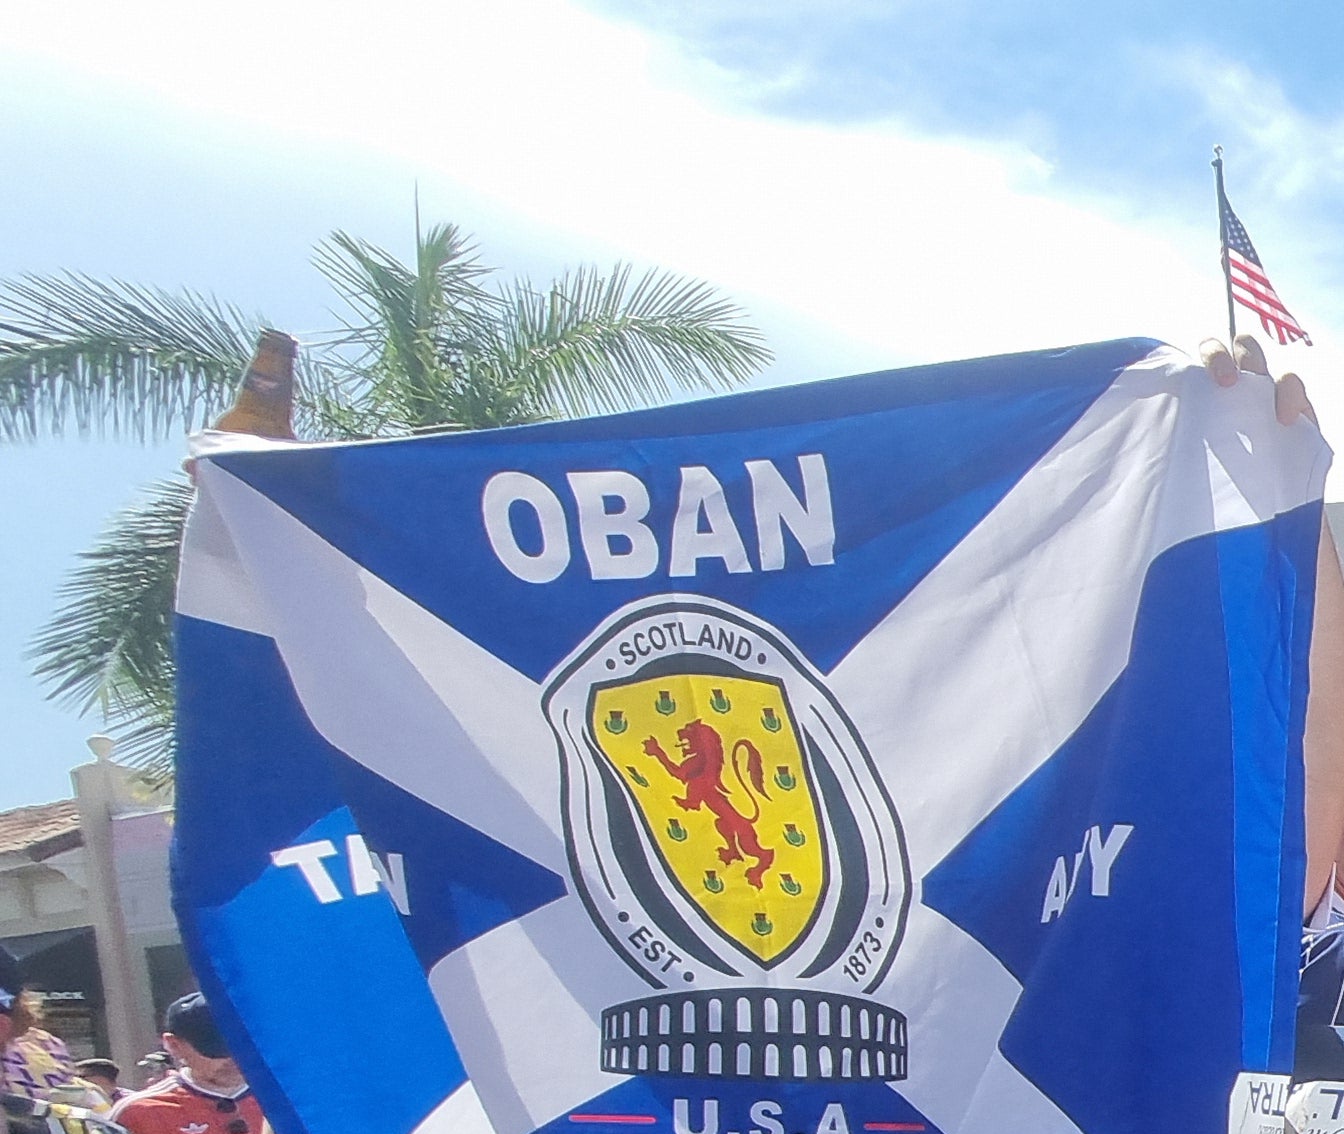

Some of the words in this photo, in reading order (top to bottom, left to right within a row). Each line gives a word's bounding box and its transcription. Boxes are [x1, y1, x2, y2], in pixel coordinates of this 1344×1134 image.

[481, 453, 835, 585] OBAN
[618, 621, 754, 667] SCOTLAND
[627, 925, 683, 975] EST
[842, 931, 883, 984] 1873
